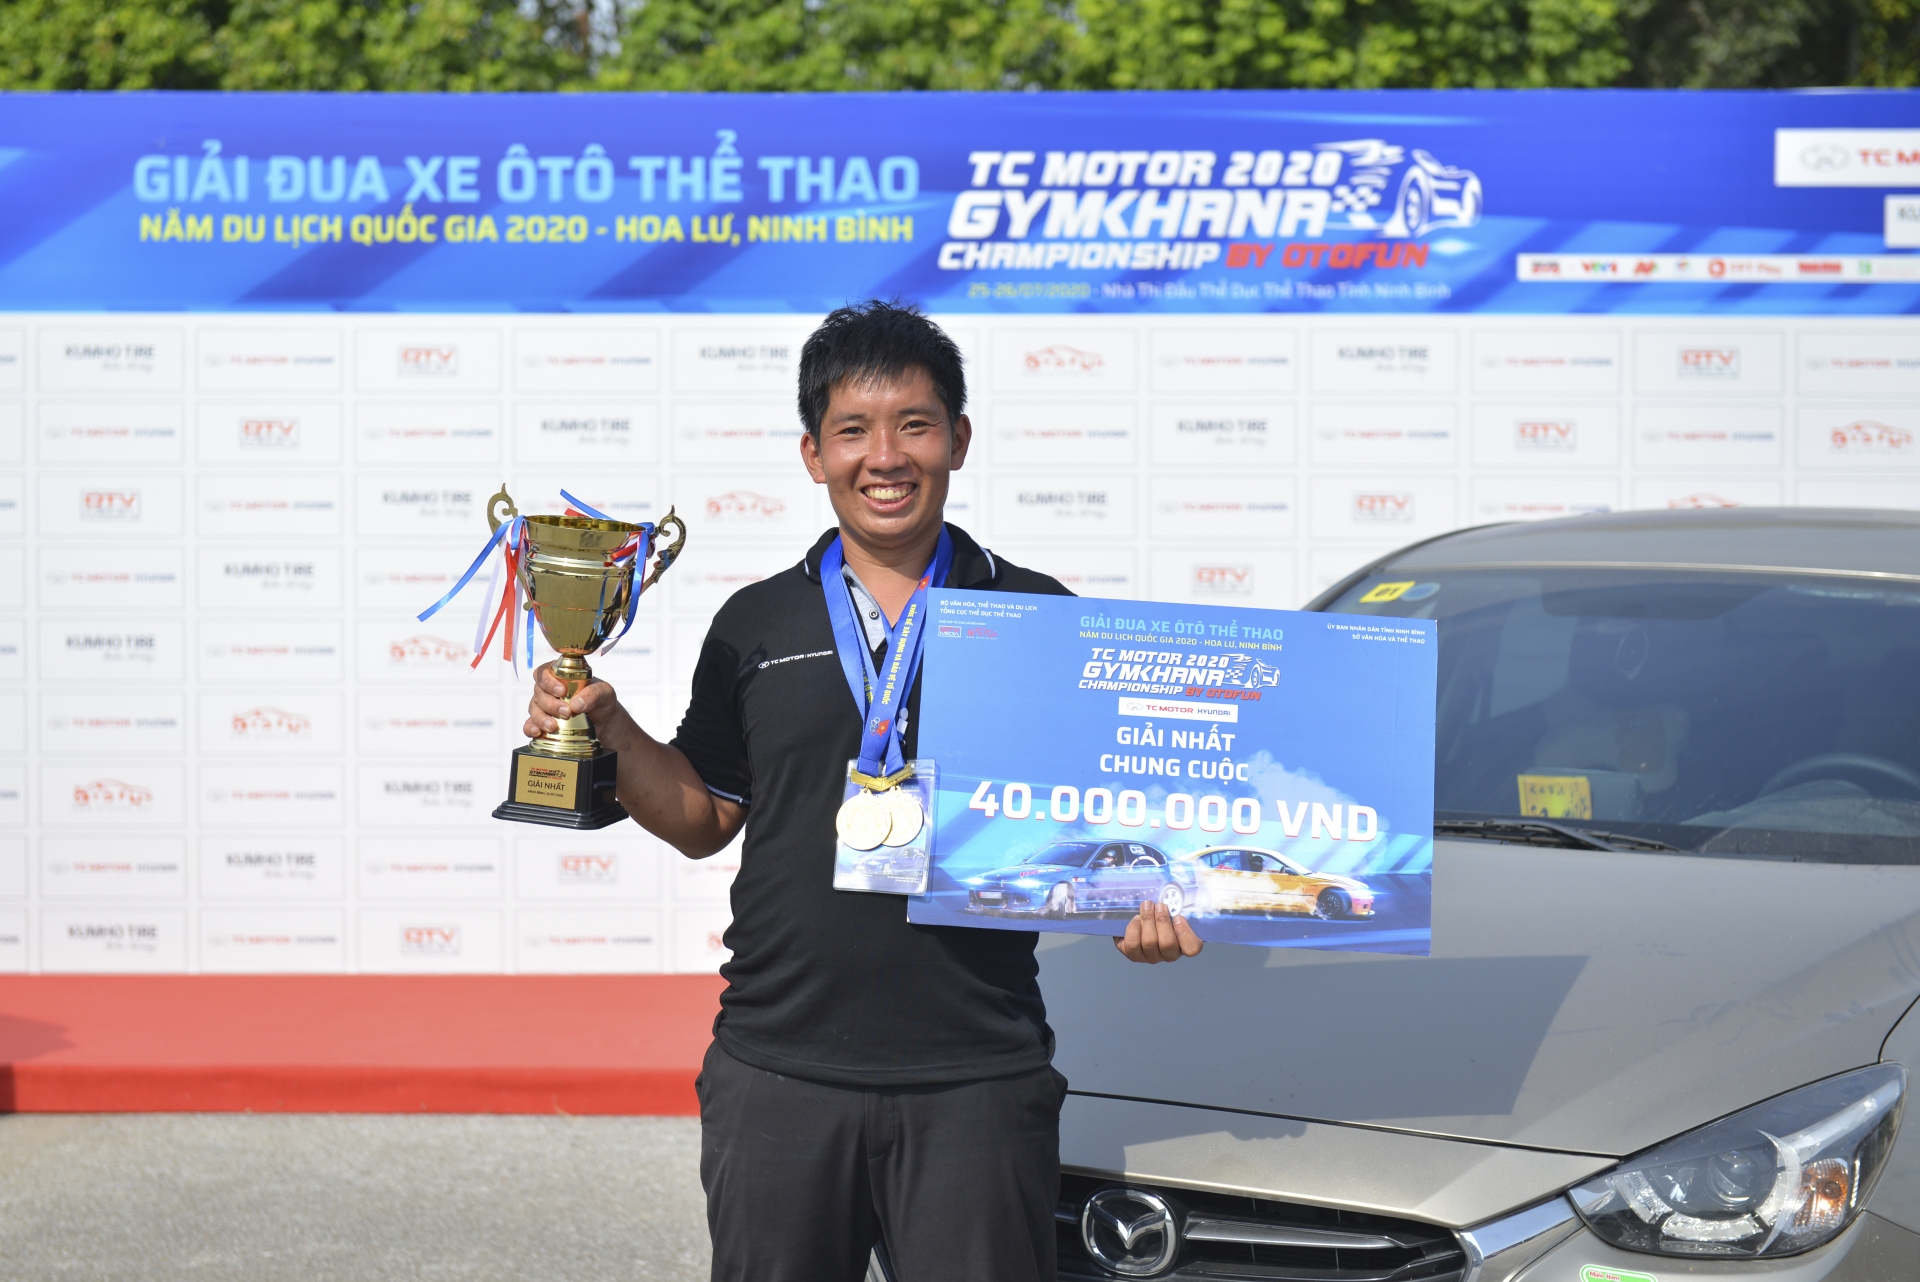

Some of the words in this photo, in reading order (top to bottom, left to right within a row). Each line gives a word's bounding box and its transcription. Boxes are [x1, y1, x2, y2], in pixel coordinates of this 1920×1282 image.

[134, 139, 249, 202] GIẢI
[266, 156, 388, 202] ĐUA
[403, 156, 480, 202] XE
[498, 144, 614, 202] ÔTÔ
[630, 130, 742, 202] THỂ
[759, 156, 918, 202] THAO
[969, 151, 1034, 187] TC
[1041, 151, 1216, 187] MOTOR
[1223, 150, 1341, 187] 2020
[139, 208, 214, 243] NĂM
[221, 214, 266, 243] DU
[273, 214, 343, 247] LỊCH
[350, 203, 438, 245] QUỐC
[444, 214, 499, 243] GIA
[505, 214, 589, 243] 2020
[615, 214, 685, 243] HOA
[690, 212, 741, 246] LƯ,
[747, 214, 828, 243] NINH
[835, 208, 914, 243] BÌNH
[948, 188, 1332, 239] GYMKHANA
[938, 242, 1220, 270] CHAMPIONSHIP
[1225, 243, 1274, 268] BY
[1282, 242, 1430, 268] OTOFUN
[1080, 612, 1111, 629] GIẢI
[1114, 616, 1147, 632] ĐUA
[1150, 620, 1171, 633] XE
[1174, 619, 1205, 635] ÔTÔ
[1208, 620, 1238, 638] THỂ
[1242, 626, 1284, 640] THAO
[1079, 630, 1099, 639] NĂM
[1101, 632, 1113, 640] DU
[1115, 632, 1133, 642] LỊCH
[1135, 632, 1158, 643] QUỐC
[1175, 637, 1197, 645] 2020
[1204, 639, 1222, 647] HOA
[1224, 640, 1237, 649] LƯ,
[1239, 641, 1260, 650] NINH
[1261, 641, 1283, 651] BÌNH
[1091, 647, 1117, 661] TC
[1118, 650, 1183, 666] MOTOR
[1185, 654, 1230, 669] 2020
[1082, 661, 1226, 687] GYMKHANA
[1078, 679, 1184, 695] CHAMPIONSHIP
[1185, 686, 1204, 697] BY
[1206, 687, 1262, 701] OTOFUN
[1159, 705, 1194, 714] MOTOR
[1197, 708, 1231, 716] HYUNDAI
[1116, 722, 1164, 746] GIẢI
[1171, 724, 1236, 752] NHẤT
[1099, 753, 1181, 778] CHUNG
[1187, 757, 1250, 786] CUỘC
[527, 780, 543, 789] GIẢI
[544, 782, 566, 792] NHẤT
[968, 781, 1261, 834] 40.000.000
[1276, 798, 1378, 842] VND
